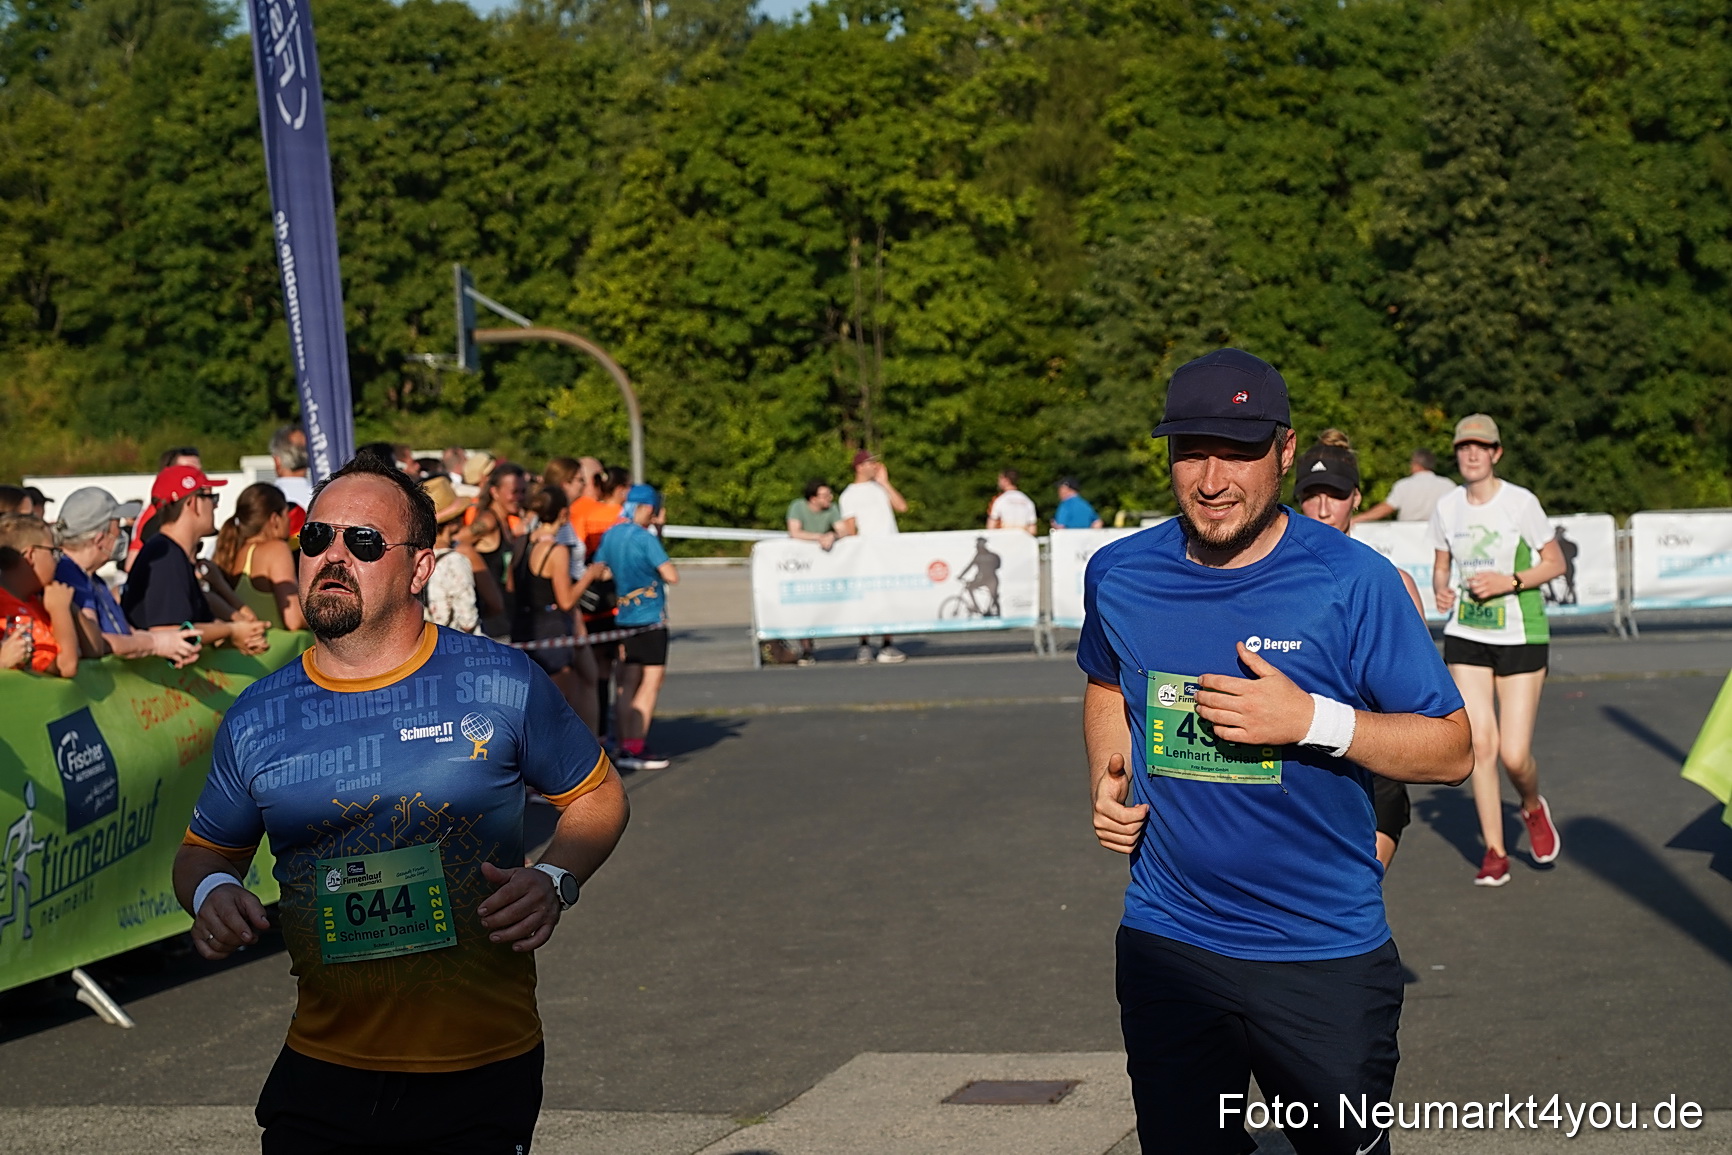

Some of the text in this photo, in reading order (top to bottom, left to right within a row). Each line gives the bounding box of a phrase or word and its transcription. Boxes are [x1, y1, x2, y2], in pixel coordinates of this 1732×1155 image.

[1263, 638, 1302, 652] Berger
[465, 655, 511, 667] GmbH
[456, 669, 529, 711] Schm
[1178, 695, 1198, 704] Firm
[301, 675, 442, 730] Schmer.IT
[400, 722, 453, 741] Schmer.IT
[1153, 719, 1165, 755] RUN
[66, 742, 105, 773] Fischer
[1166, 746, 1260, 765] Lenhart Florian
[1261, 748, 1274, 769] 20
[335, 772, 382, 793] GmbH
[42, 778, 162, 899] firmenlauf
[342, 870, 382, 885] Firmenlauf
[358, 879, 383, 888] neumarkt
[345, 885, 416, 926] 644
[428, 885, 447, 932] 2022
[323, 907, 337, 942] RUN
[340, 920, 430, 942] Schmer Daniel
